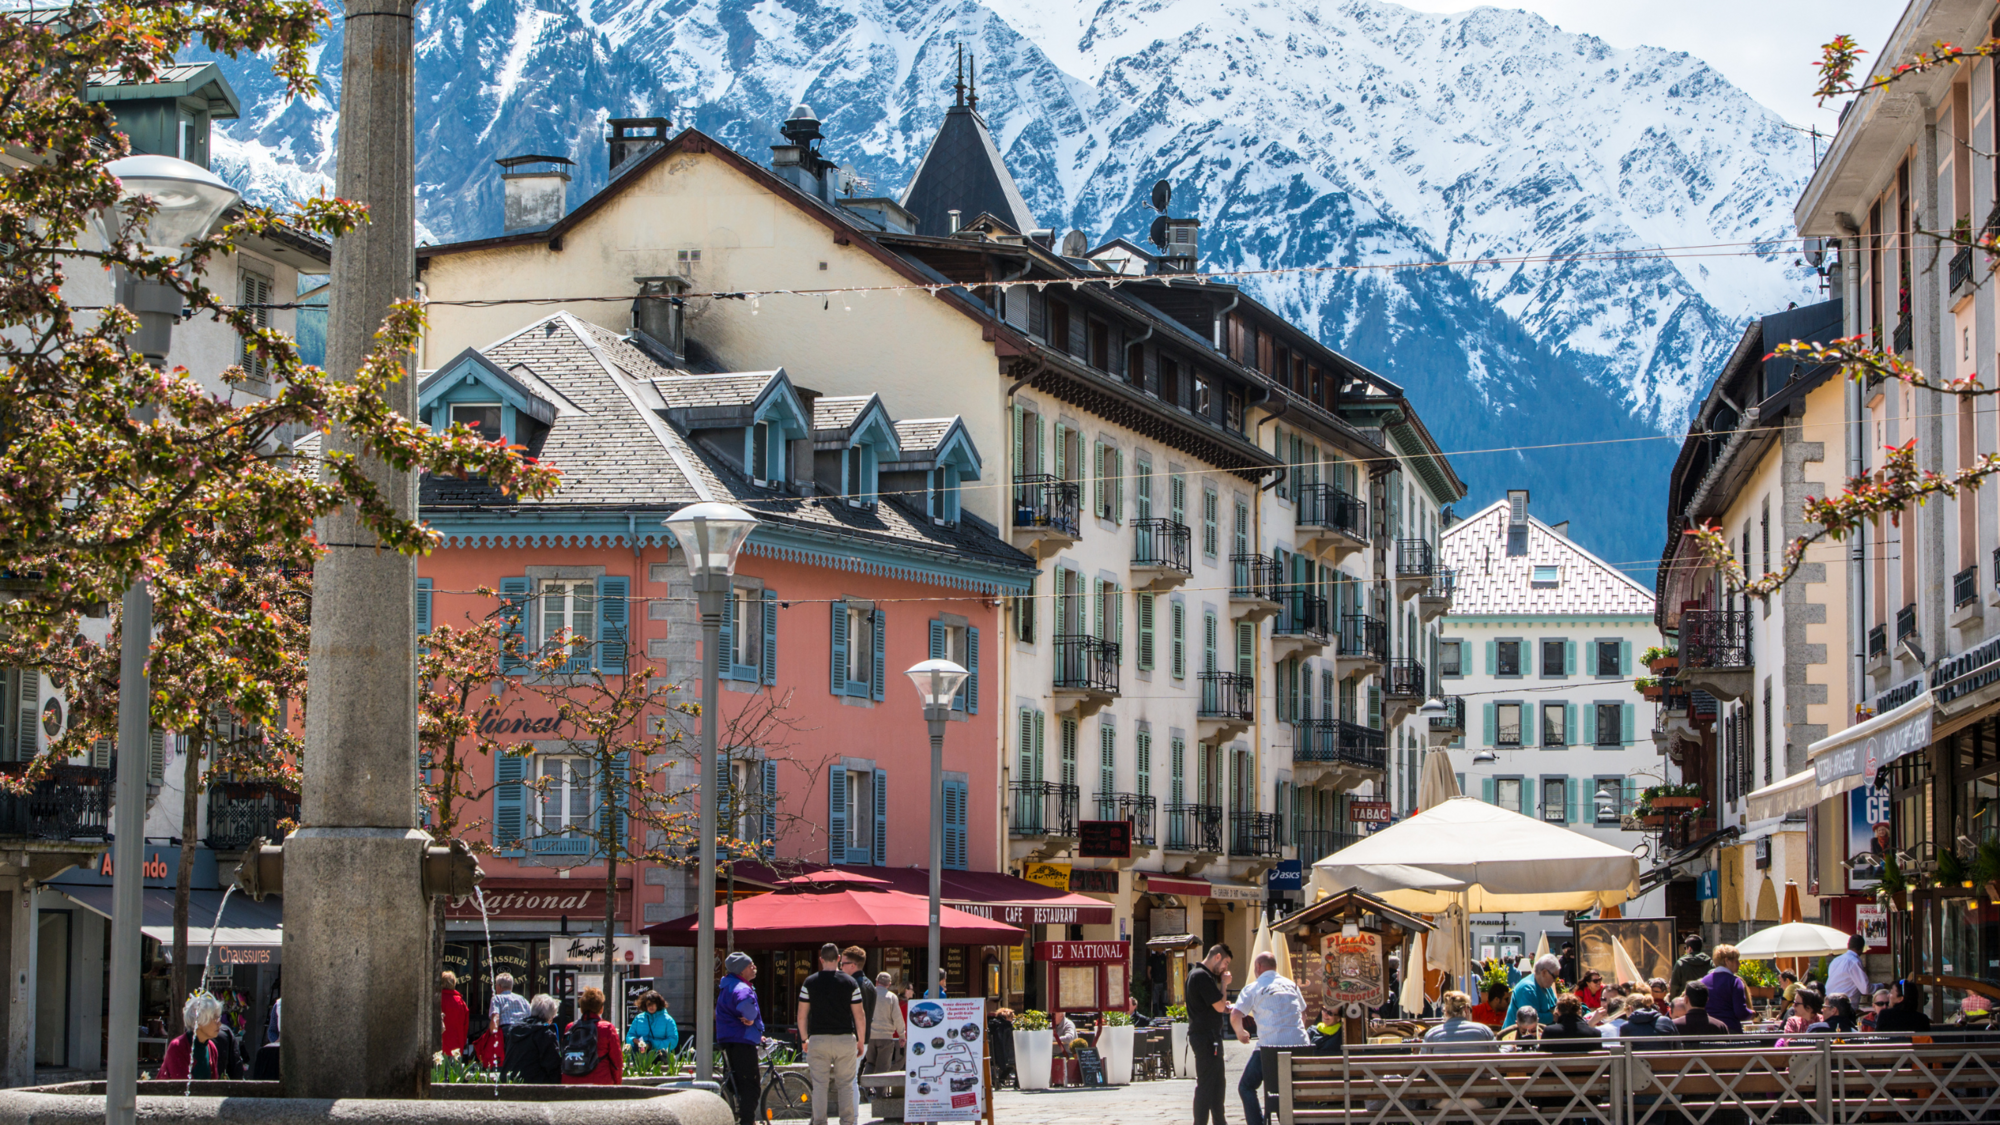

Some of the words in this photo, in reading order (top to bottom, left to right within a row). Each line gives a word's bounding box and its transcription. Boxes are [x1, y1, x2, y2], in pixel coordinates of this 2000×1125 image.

[1353, 808, 1387, 820] TABAC
[101, 852, 168, 878] Ando
[1279, 871, 1300, 880] asics
[450, 889, 593, 915] National
[1005, 907, 1023, 922] CAFE
[1034, 907, 1078, 923] RESTAURANT
[1326, 934, 1376, 948] PIZZAS
[219, 946, 271, 963] Chaussures
[567, 939, 619, 962] Atmosphèe
[1052, 945, 1064, 959] LE
[1070, 944, 1124, 959] NATIONAL
[443, 955, 468, 967] DUES
[1335, 987, 1380, 1004] emporter
